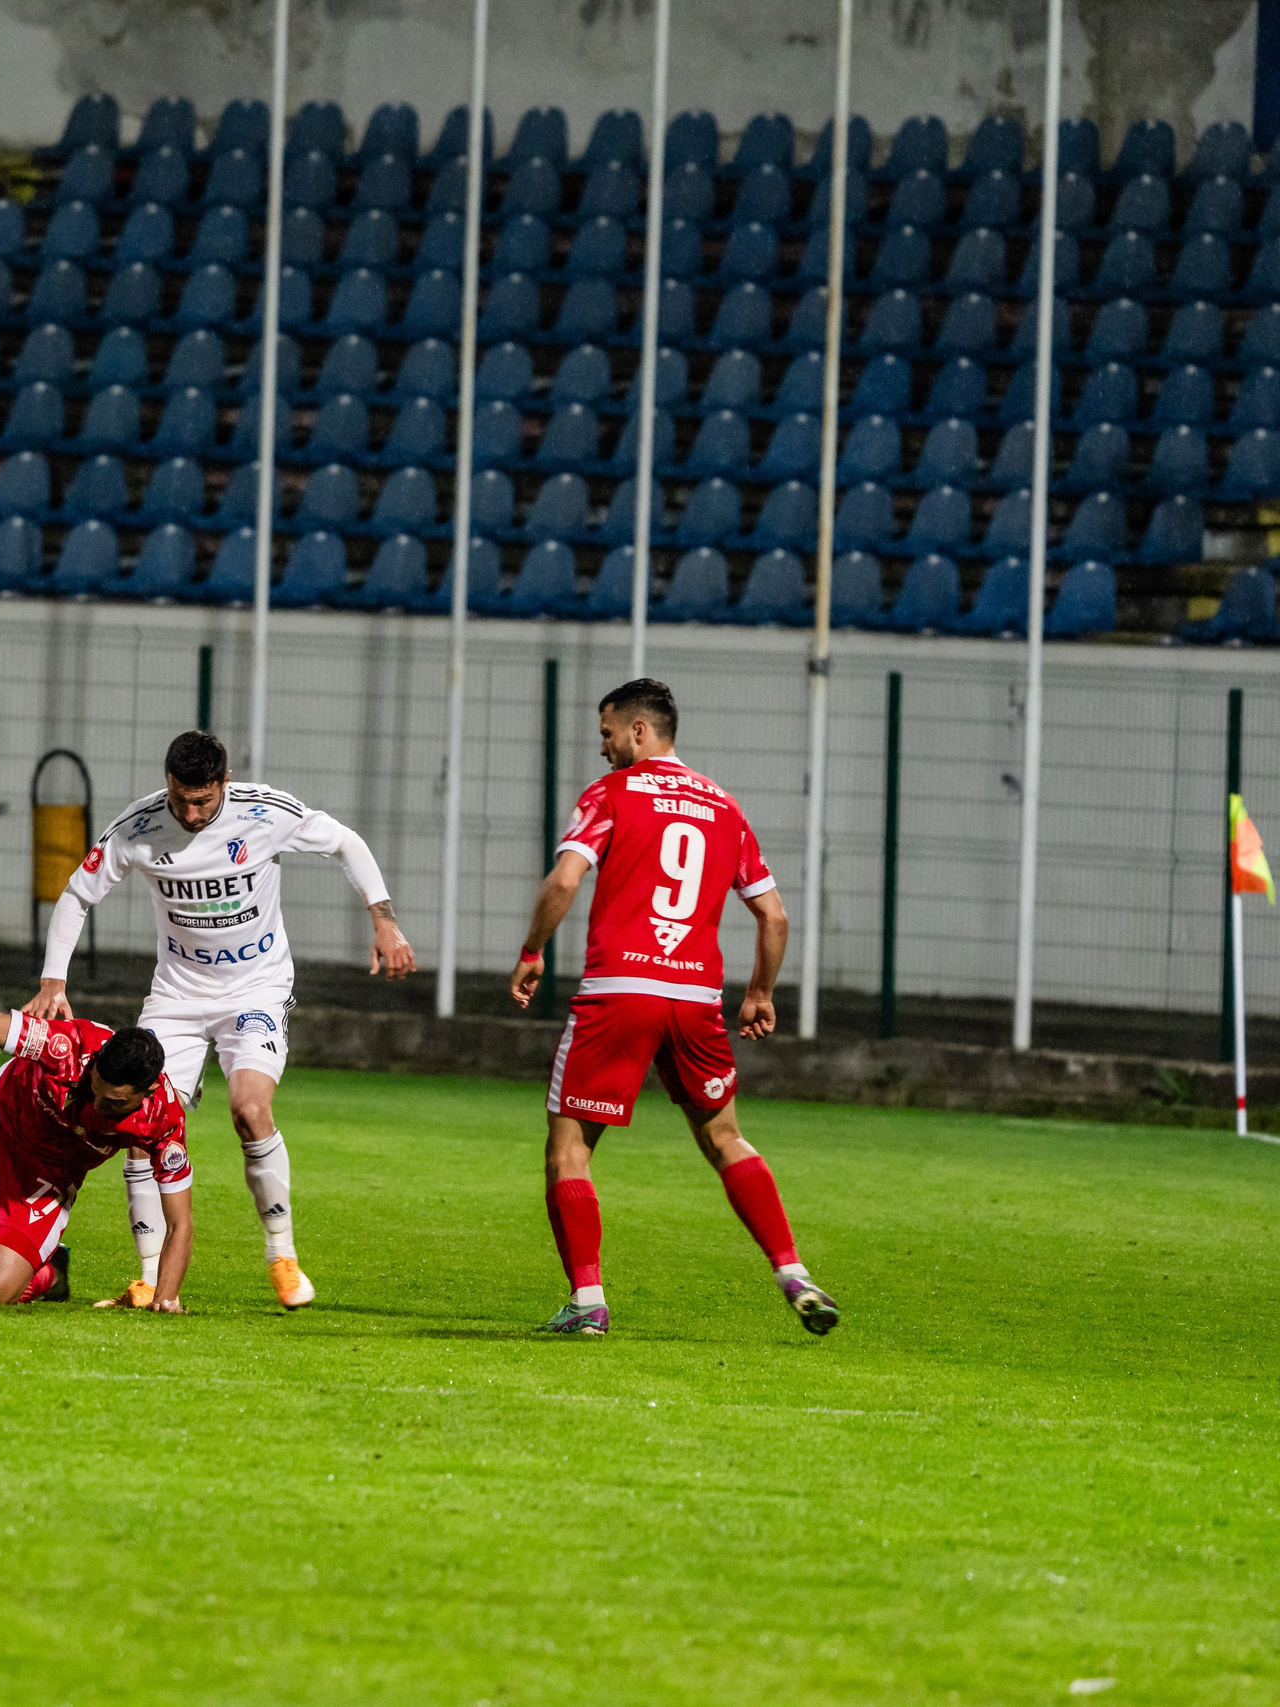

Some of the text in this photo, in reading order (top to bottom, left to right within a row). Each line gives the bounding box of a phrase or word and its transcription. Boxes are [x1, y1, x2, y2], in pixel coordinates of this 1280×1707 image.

[640, 772, 726, 798] Regata.ro
[652, 797, 716, 823] SELMANI
[651, 821, 707, 920] 9
[157, 872, 257, 900] UNIBET
[216, 916, 240, 928] SPRE
[240, 910, 255, 923] 0%
[167, 932, 275, 966] ELSACO
[652, 955, 705, 972] GAMING
[566, 1095, 624, 1116] CARPATINA
